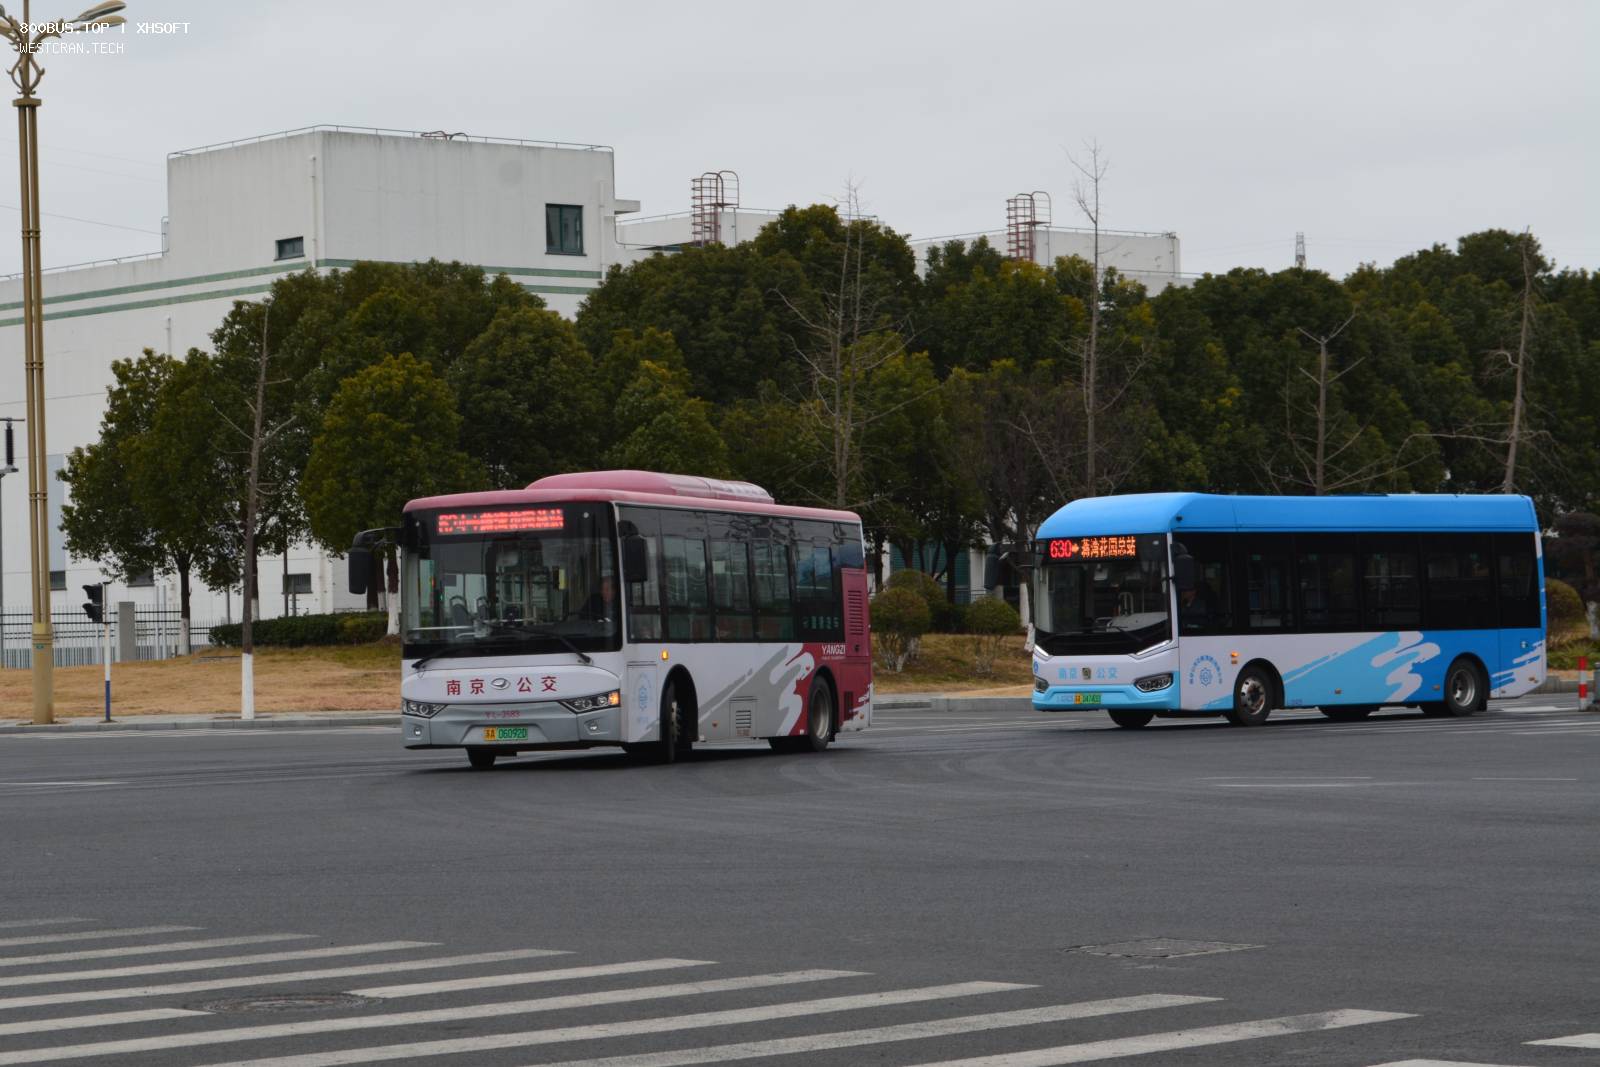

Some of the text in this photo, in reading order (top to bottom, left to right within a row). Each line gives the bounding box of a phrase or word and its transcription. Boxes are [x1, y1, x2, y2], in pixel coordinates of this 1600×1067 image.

[1050, 540, 1072, 558] 630
[821, 644, 846, 655] YANGZI
[446, 676, 557, 696] 南京 公交
